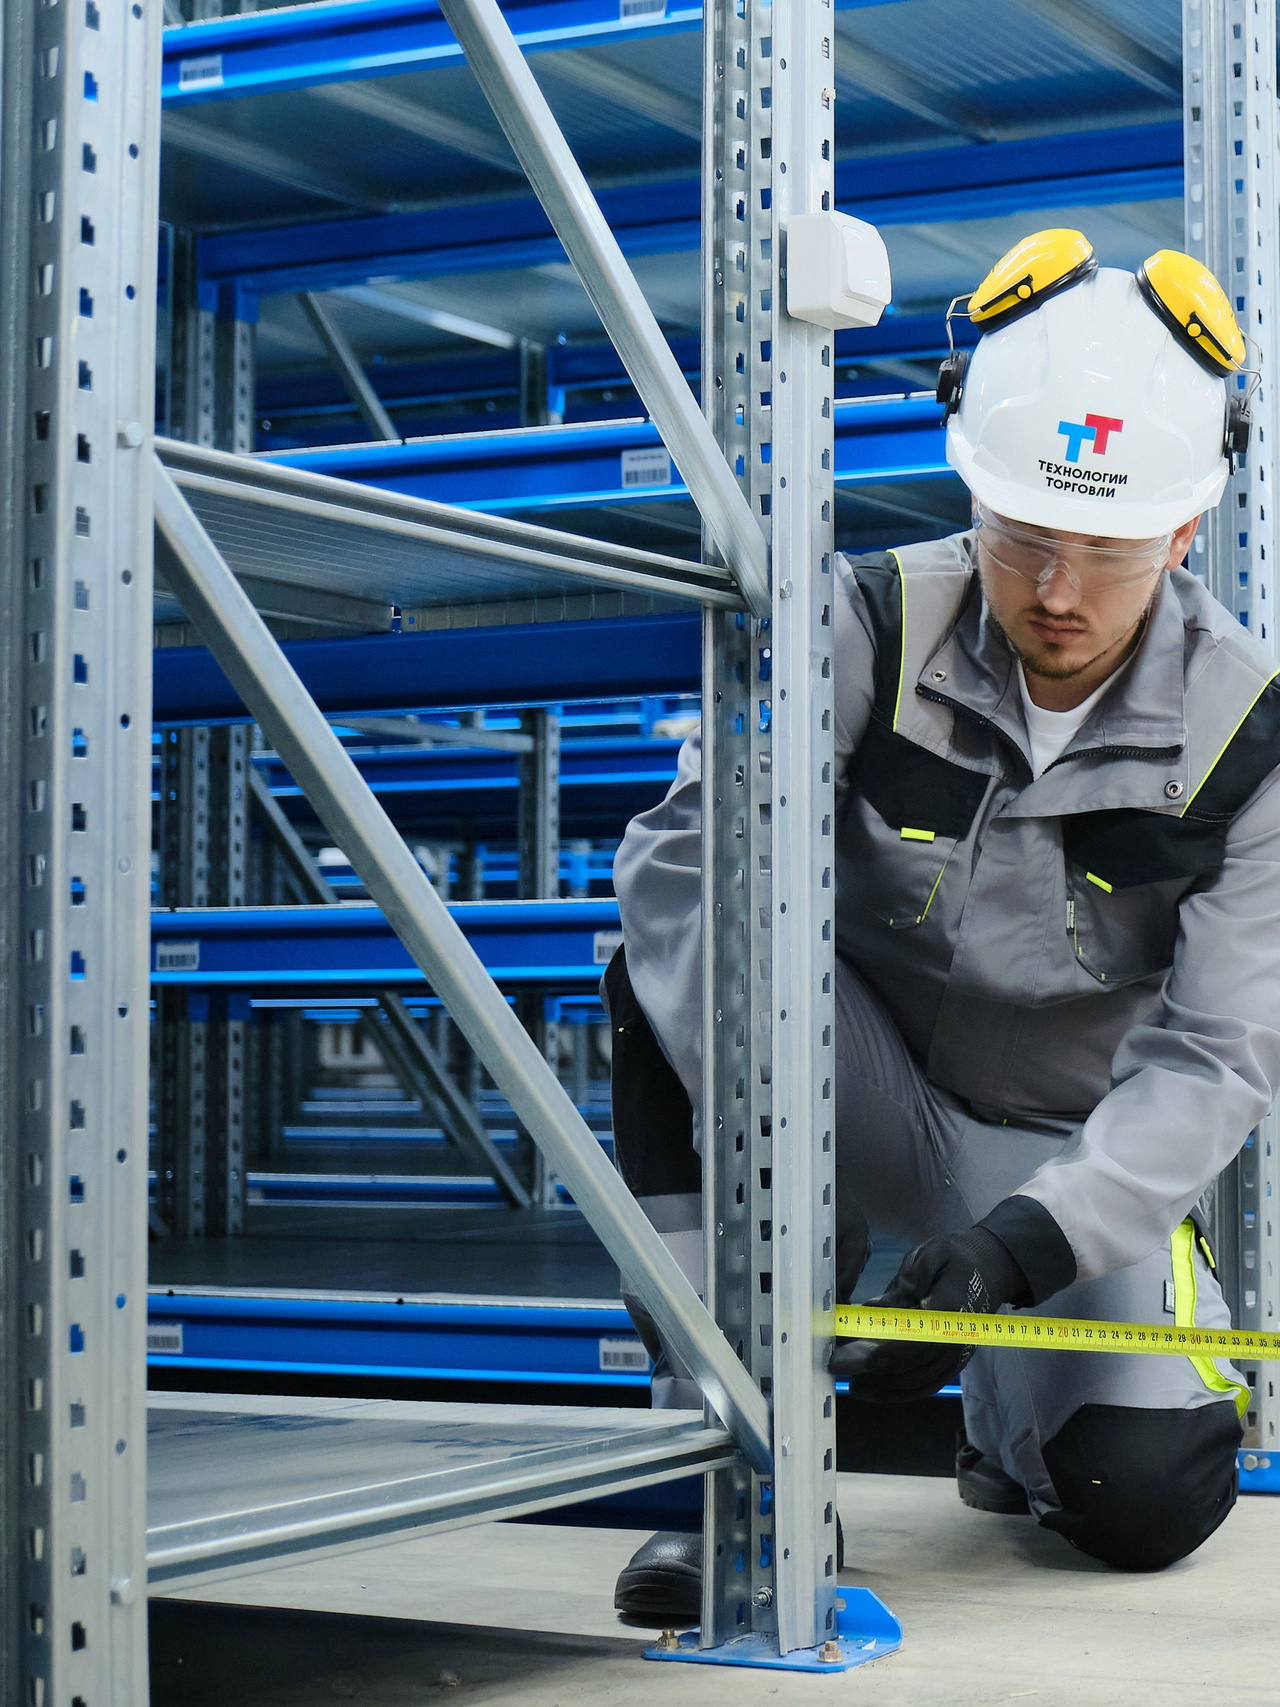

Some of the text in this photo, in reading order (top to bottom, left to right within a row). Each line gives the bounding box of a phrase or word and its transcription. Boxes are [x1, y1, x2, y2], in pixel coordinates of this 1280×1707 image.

[1038, 459, 1128, 485] ТЕХНОЛОГИИ
[1046, 476, 1116, 498] ТОРГОВЛИ
[844, 1316, 849, 1325] 3
[856, 1317, 860, 1325] 4
[869, 1317, 874, 1326] 5
[881, 1318, 886, 1327] 6
[894, 1318, 899, 1327] 7
[906, 1319, 910, 1328] 8
[919, 1320, 923, 1329] 9
[930, 1319, 940, 1330] 10
[944, 1321, 950, 1330] 11
[956, 1322, 963, 1331] 12
[969, 1322, 976, 1331] 13
[982, 1323, 989, 1332] 14
[994, 1324, 1002, 1333] 15
[1008, 1324, 1014, 1333] 16
[1020, 1325, 1027, 1334] 17
[1033, 1326, 1040, 1335] 18
[1046, 1327, 1054, 1336] 19
[1057, 1326, 1068, 1337] 20
[1071, 1328, 1079, 1337] 21
[1084, 1329, 1092, 1338] 22
[1098, 1329, 1106, 1338] 23
[1111, 1330, 1119, 1339] 24
[1124, 1331, 1132, 1340] 25
[1137, 1331, 1146, 1340] 26
[1150, 1332, 1158, 1341] 27
[1164, 1333, 1172, 1342] 28
[1178, 1334, 1186, 1342] 29
[1190, 1333, 1201, 1344] 30
[1204, 1335, 1212, 1344] 31
[1218, 1336, 1226, 1345] 32
[1231, 1336, 1240, 1345] 33
[1245, 1337, 1253, 1346] 34
[1258, 1338, 1267, 1347] 35
[1272, 1339, 1280, 1348] 36
